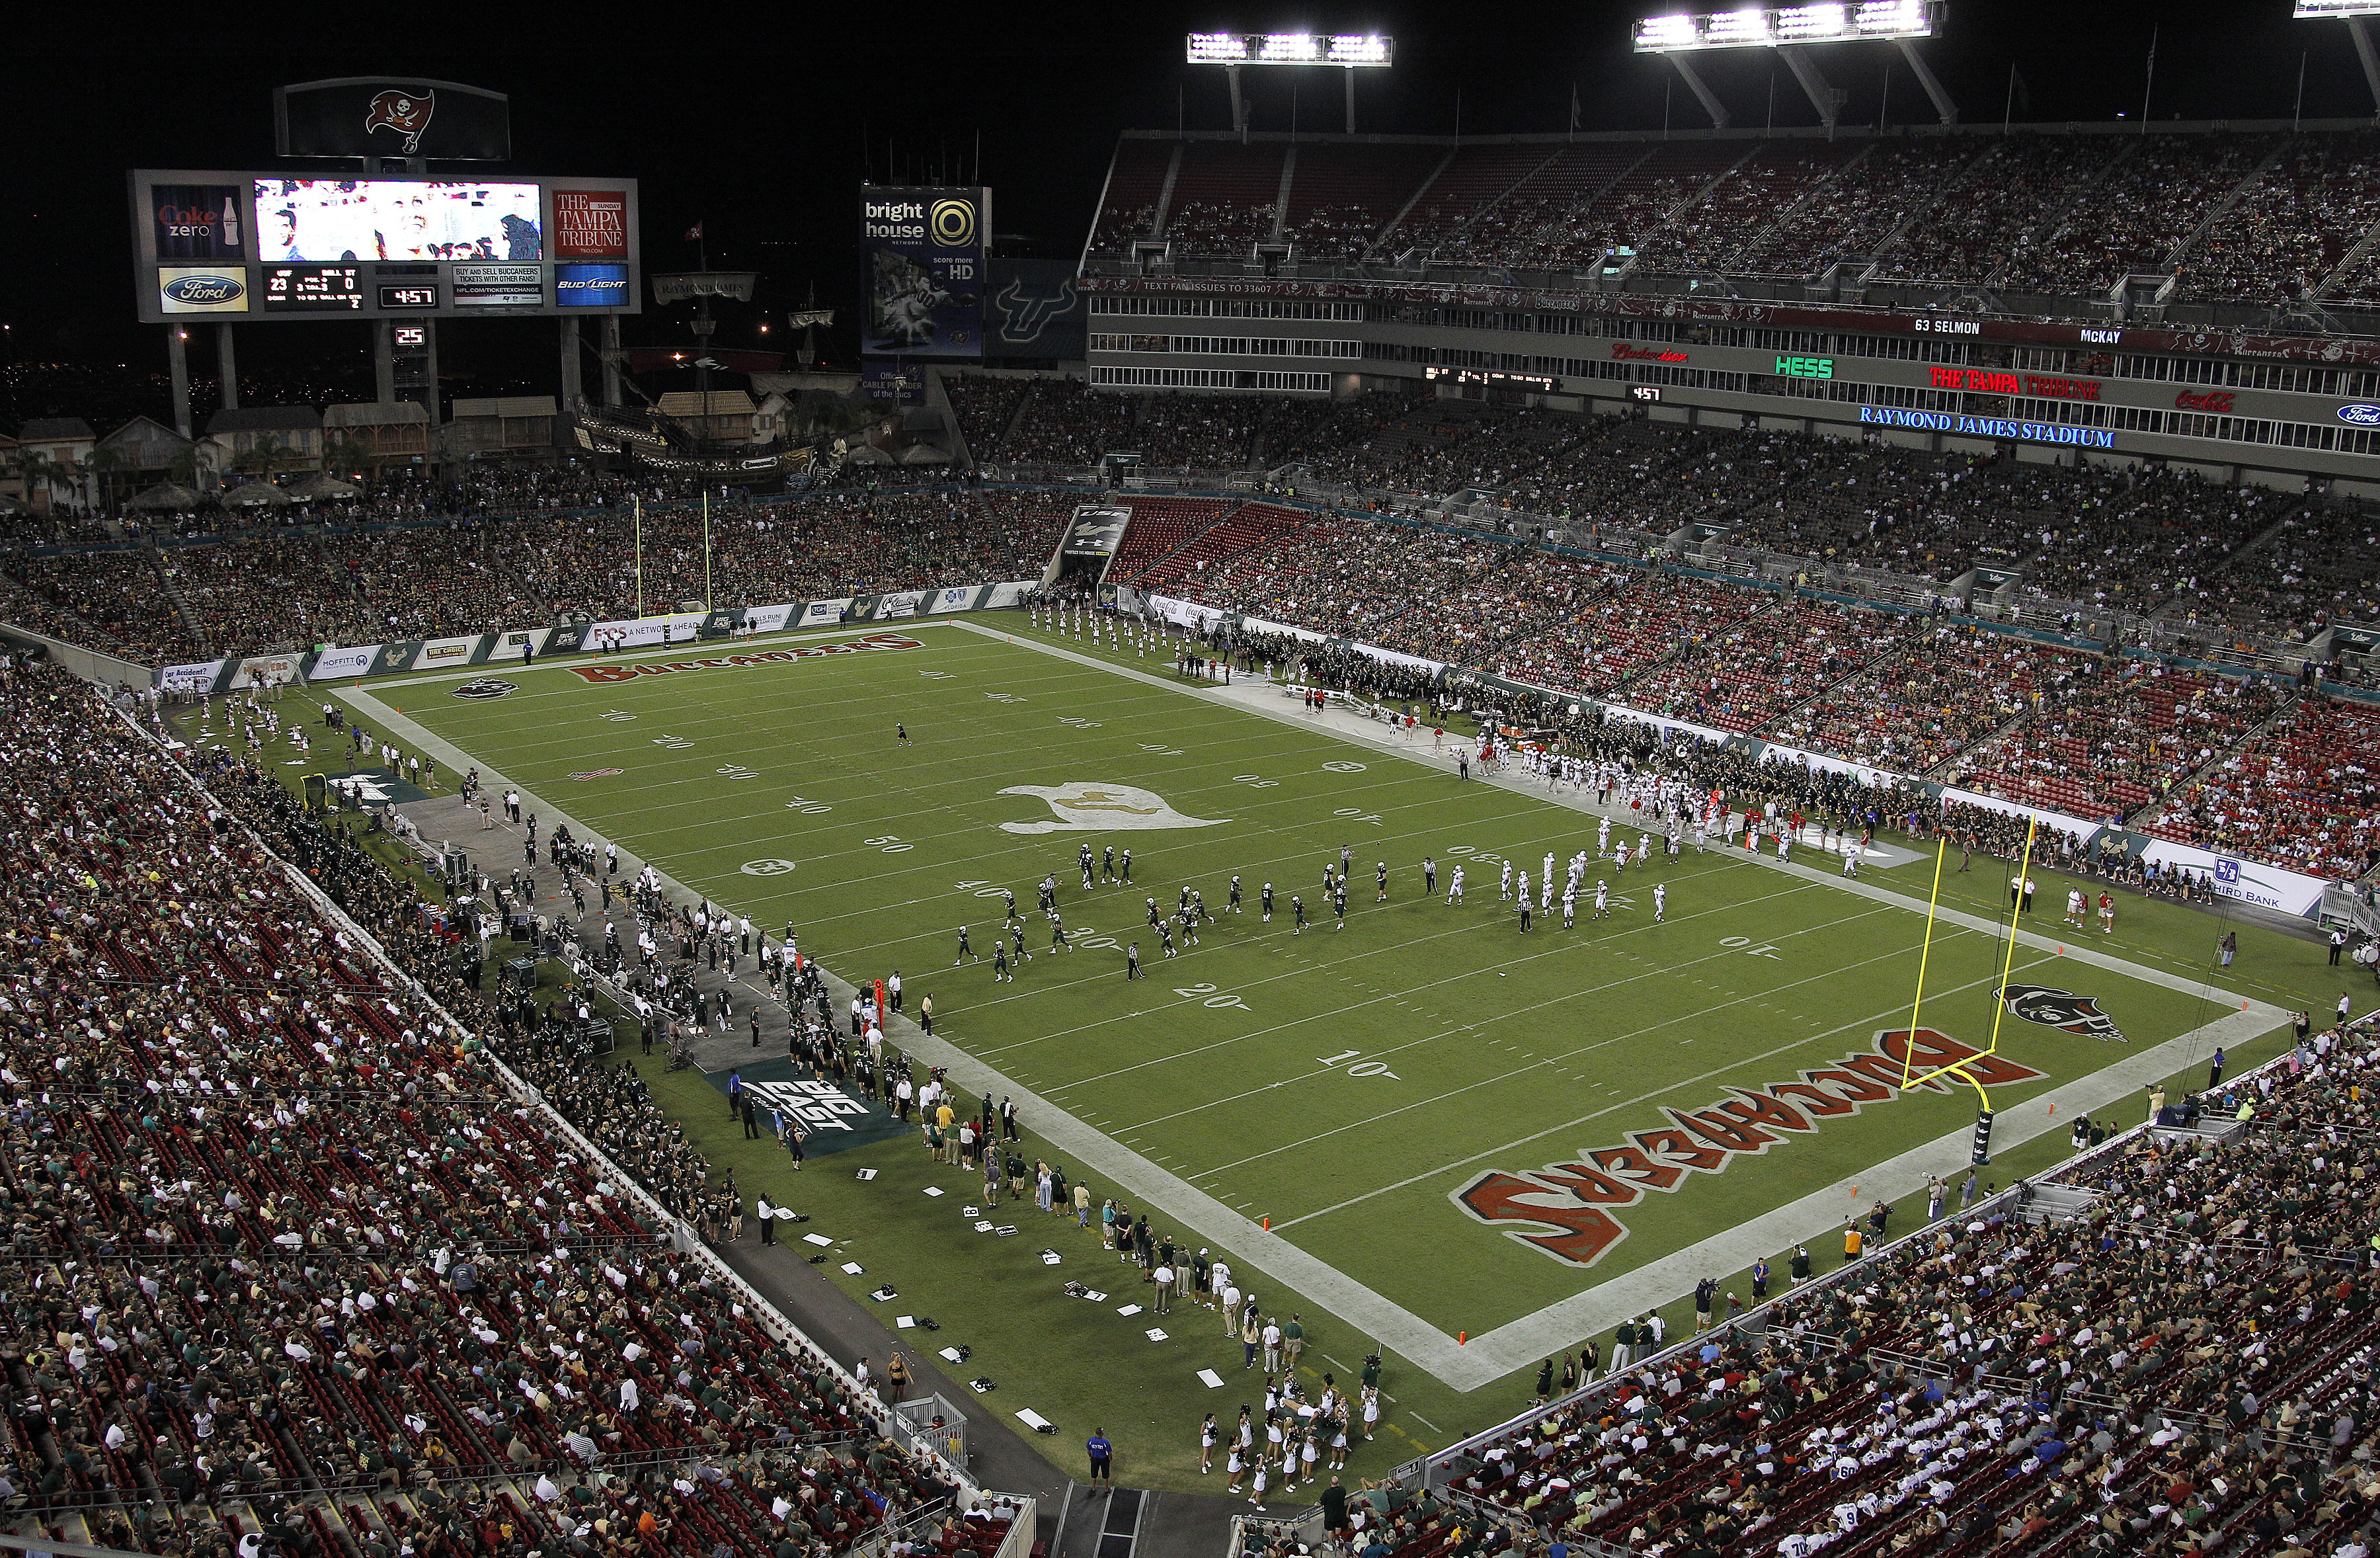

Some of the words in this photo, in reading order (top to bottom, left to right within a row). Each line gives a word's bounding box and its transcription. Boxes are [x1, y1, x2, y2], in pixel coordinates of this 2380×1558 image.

[558, 194, 588, 210] THE
[159, 205, 218, 226] Coke
[865, 202, 923, 221] bright
[559, 211, 621, 231] TAMPA
[169, 226, 210, 237] zero
[865, 222, 924, 238] house
[559, 231, 622, 247] TRIBUNE
[950, 265, 974, 280] HD
[180, 279, 228, 300] Ford
[270, 278, 287, 291] 23
[344, 277, 354, 290] 0
[662, 284, 712, 294] RAYMOND
[1144, 282, 1168, 290] TEXT
[1170, 282, 1189, 291] FAN
[1191, 283, 1226, 292] ISSUES
[1228, 284, 1242, 293] TO
[1244, 284, 1272, 294] 33607
[351, 299, 359, 309] 2
[395, 290, 432, 304] 4:57
[1915, 319, 1930, 331] 63
[1934, 320, 1980, 335] SELMON
[397, 329, 422, 343] 25
[2081, 329, 2121, 344] McKAY
[1612, 343, 1688, 362] Budweiser
[1776, 355, 1833, 379] HESS
[887, 381, 922, 390] PRIDER
[1929, 366, 1964, 389] THE
[1966, 369, 2020, 394] TAMPA
[2024, 374, 2100, 400] TRIBUNE
[1634, 387, 1659, 401] 4:57
[2346, 405, 2379, 424] Ford
[1859, 406, 1951, 431] RAYMOND
[1956, 416, 2018, 438] JAMES
[2021, 423, 2114, 448] STADIUM
[510, 634, 529, 645] USF
[594, 626, 627, 642] FOS
[673, 622, 698, 630] AHEAD
[323, 657, 355, 667] MOFFITT
[565, 633, 926, 683] BUCCANEERS
[599, 709, 637, 722] 10
[652, 734, 695, 749] 20
[716, 763, 760, 780] 30
[785, 795, 832, 815] 40
[863, 835, 914, 853] 50
[953, 880, 1008, 897] 40
[2246, 891, 2280, 909] BANK
[1172, 982, 1243, 1009] 20
[1316, 1049, 1389, 1078] 10
[793, 1080, 870, 1115] BIG
[758, 1081, 854, 1131] EAST
[1448, 1024, 2049, 1268] BUCCANEERS
[1840, 1466, 1855, 1479] 60
[1846, 1512, 1856, 1525] 9
[1792, 1542, 1806, 1557] 70
